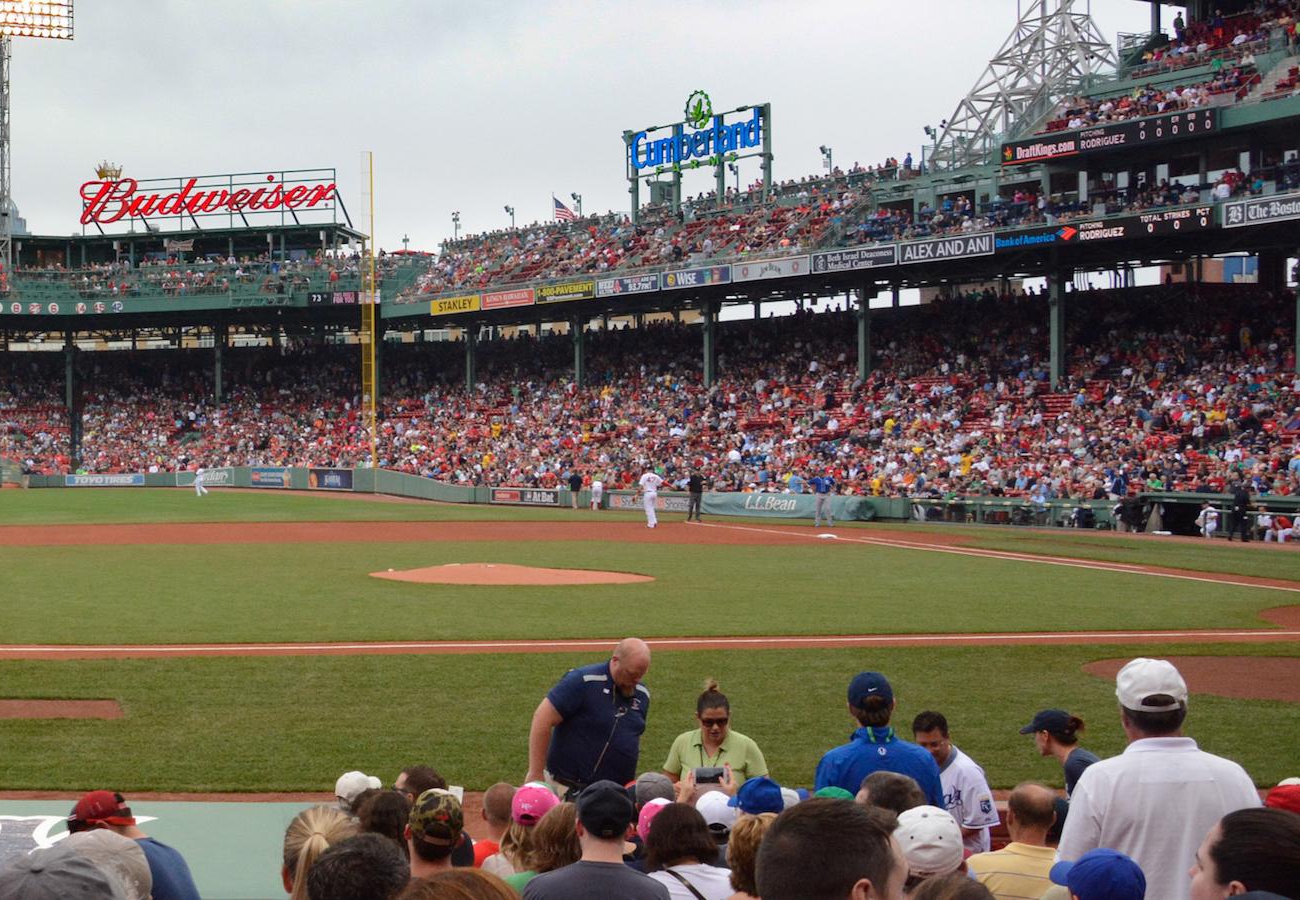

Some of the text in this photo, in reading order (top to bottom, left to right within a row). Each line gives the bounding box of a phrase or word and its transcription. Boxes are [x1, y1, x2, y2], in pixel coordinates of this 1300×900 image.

[1172, 125, 1178, 135] 0
[1189, 122, 1194, 132] 0
[1205, 119, 1211, 129] 0
[631, 106, 760, 169] Cumberland
[1140, 130, 1146, 140] 0
[1156, 127, 1162, 137] 0
[1080, 134, 1125, 150] RODRIGUEZ
[1016, 141, 1075, 159] DraftKings.com
[80, 178, 336, 224] Budweiser
[1140, 210, 1190, 223] TOTAL STRIKES
[1196, 207, 1209, 216] PCT
[1247, 204, 1268, 219] The
[1148, 223, 1154, 233] 0
[1174, 220, 1180, 230] 0
[1201, 217, 1207, 227] 0
[1079, 227, 1124, 240] RODRIGUEZ
[995, 233, 1055, 248] Bank of America
[904, 237, 990, 260] ALEX AND ANI
[827, 249, 892, 262] Beth Israel Deaconess
[827, 259, 873, 270] Medical Center
[676, 272, 697, 285] WISE
[537, 283, 593, 297] 1-800-PAVEMENT
[311, 294, 322, 302] 73
[438, 298, 473, 312] STANLEY
[75, 476, 134, 484] TOYO TIRES
[745, 496, 797, 511] L.L.Bean
